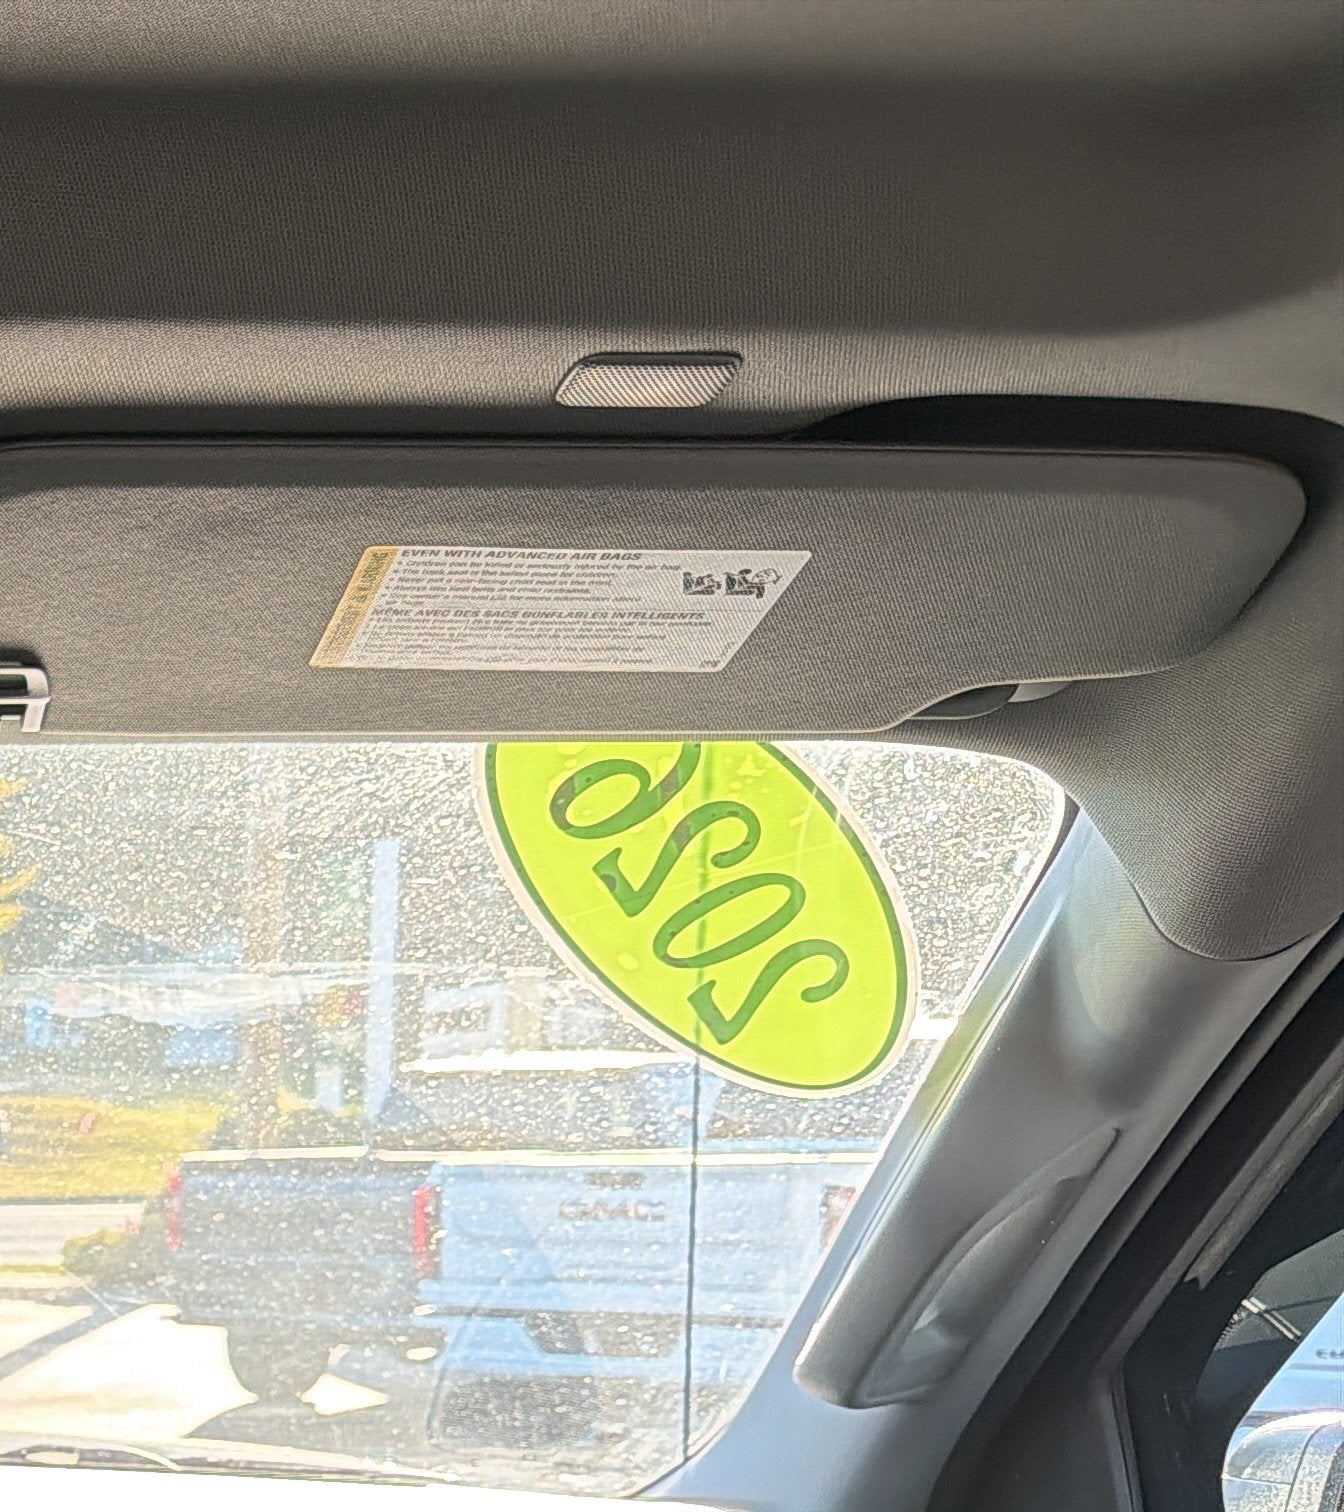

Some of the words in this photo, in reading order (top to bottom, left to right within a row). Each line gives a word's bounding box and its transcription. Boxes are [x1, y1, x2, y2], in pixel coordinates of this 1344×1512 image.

[443, 550, 482, 558] WITH
[484, 551, 568, 560] ADVANCED
[570, 552, 597, 560] AIR
[413, 609, 449, 618] AVEC
[452, 609, 480, 618] DES
